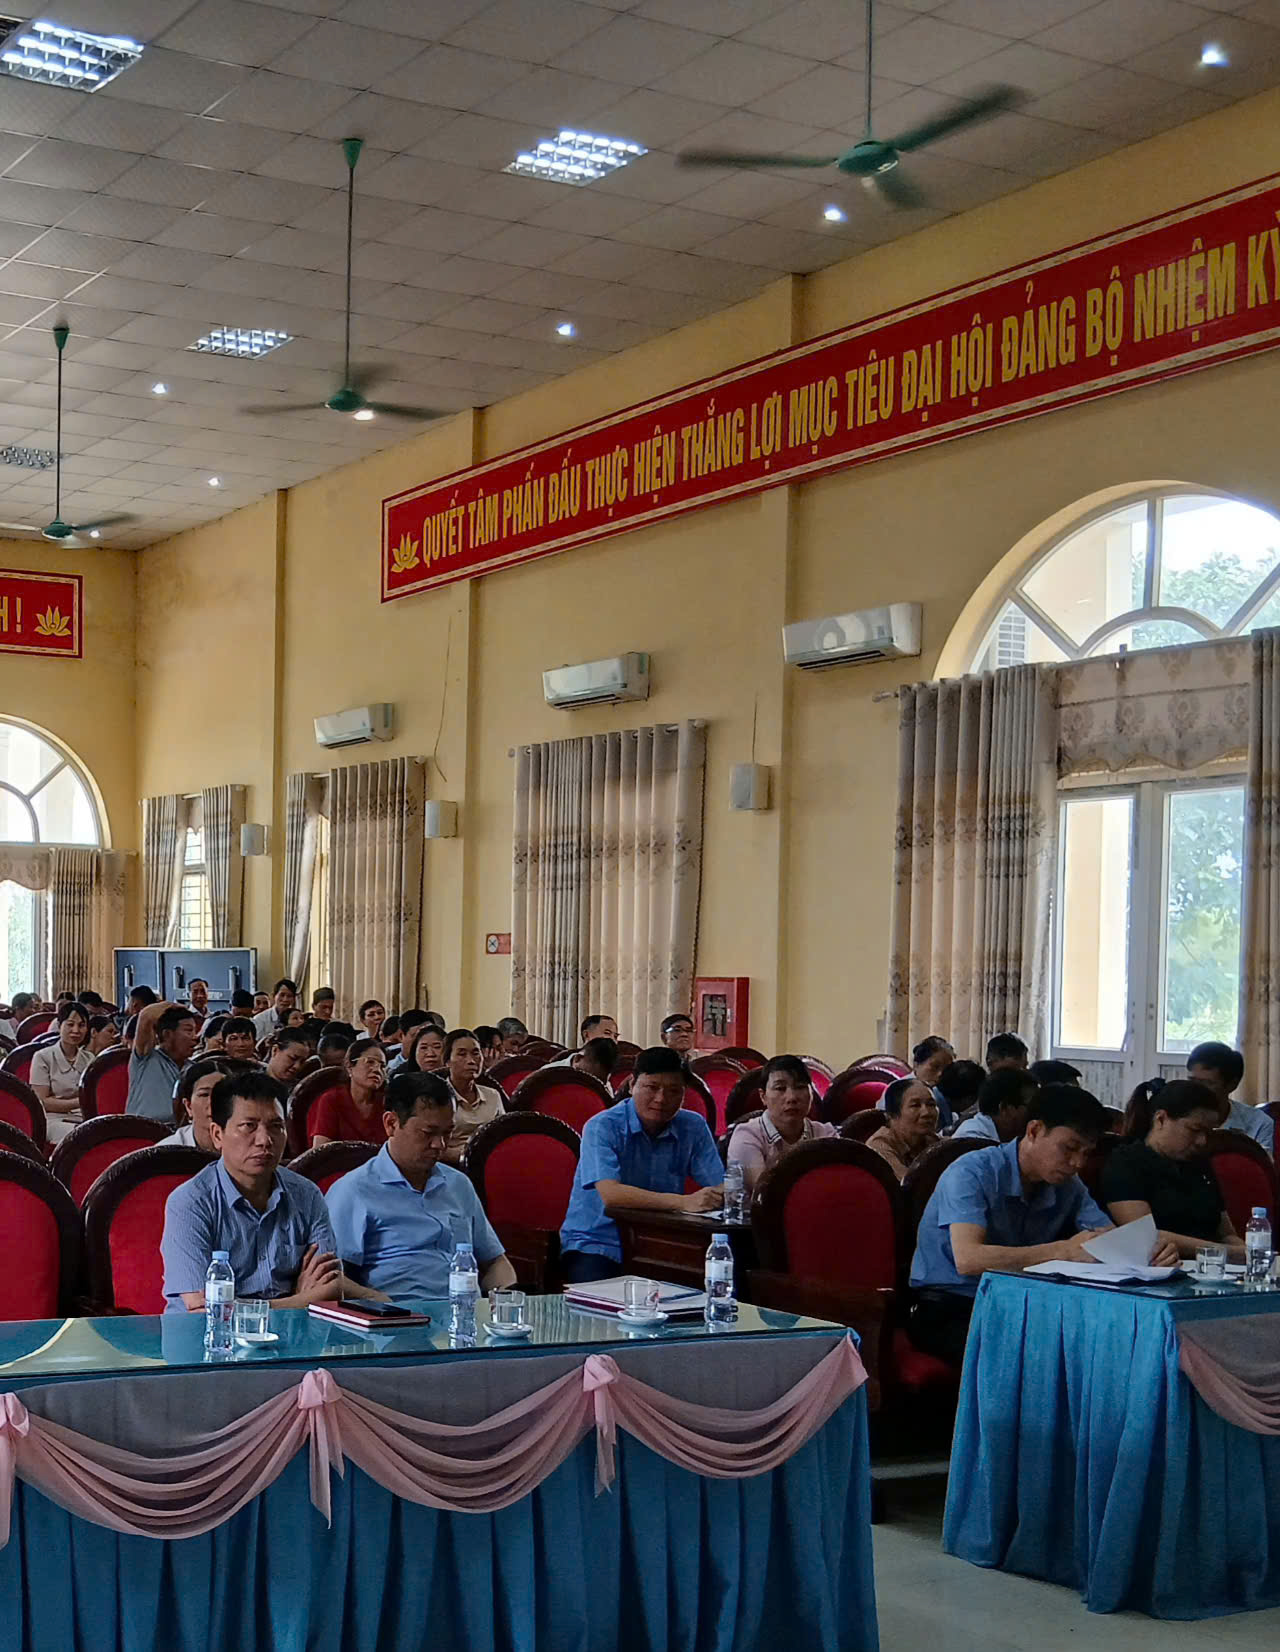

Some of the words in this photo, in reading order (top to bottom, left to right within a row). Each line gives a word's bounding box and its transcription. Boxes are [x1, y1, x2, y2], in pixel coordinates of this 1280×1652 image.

[422, 489, 465, 569] QUYẾT
[467, 488, 499, 549] TÂM
[502, 461, 545, 539] PHẤN
[548, 448, 581, 524] ĐẤU
[585, 445, 628, 517] THỰC
[633, 424, 676, 504] HIỆN
[681, 398, 745, 481] THẮNG
[750, 391, 783, 470] LỢI
[788, 375, 838, 455] MỤC
[845, 349, 894, 430] TIÊU
[901, 340, 943, 422] ĐẠI
[950, 312, 993, 407] HỘI
[1001, 280, 1076, 383] ĐẢNG
[1085, 265, 1124, 367] BỘ
[1133, 238, 1236, 342] NHIỆM
[16, 597, 22, 633] !
